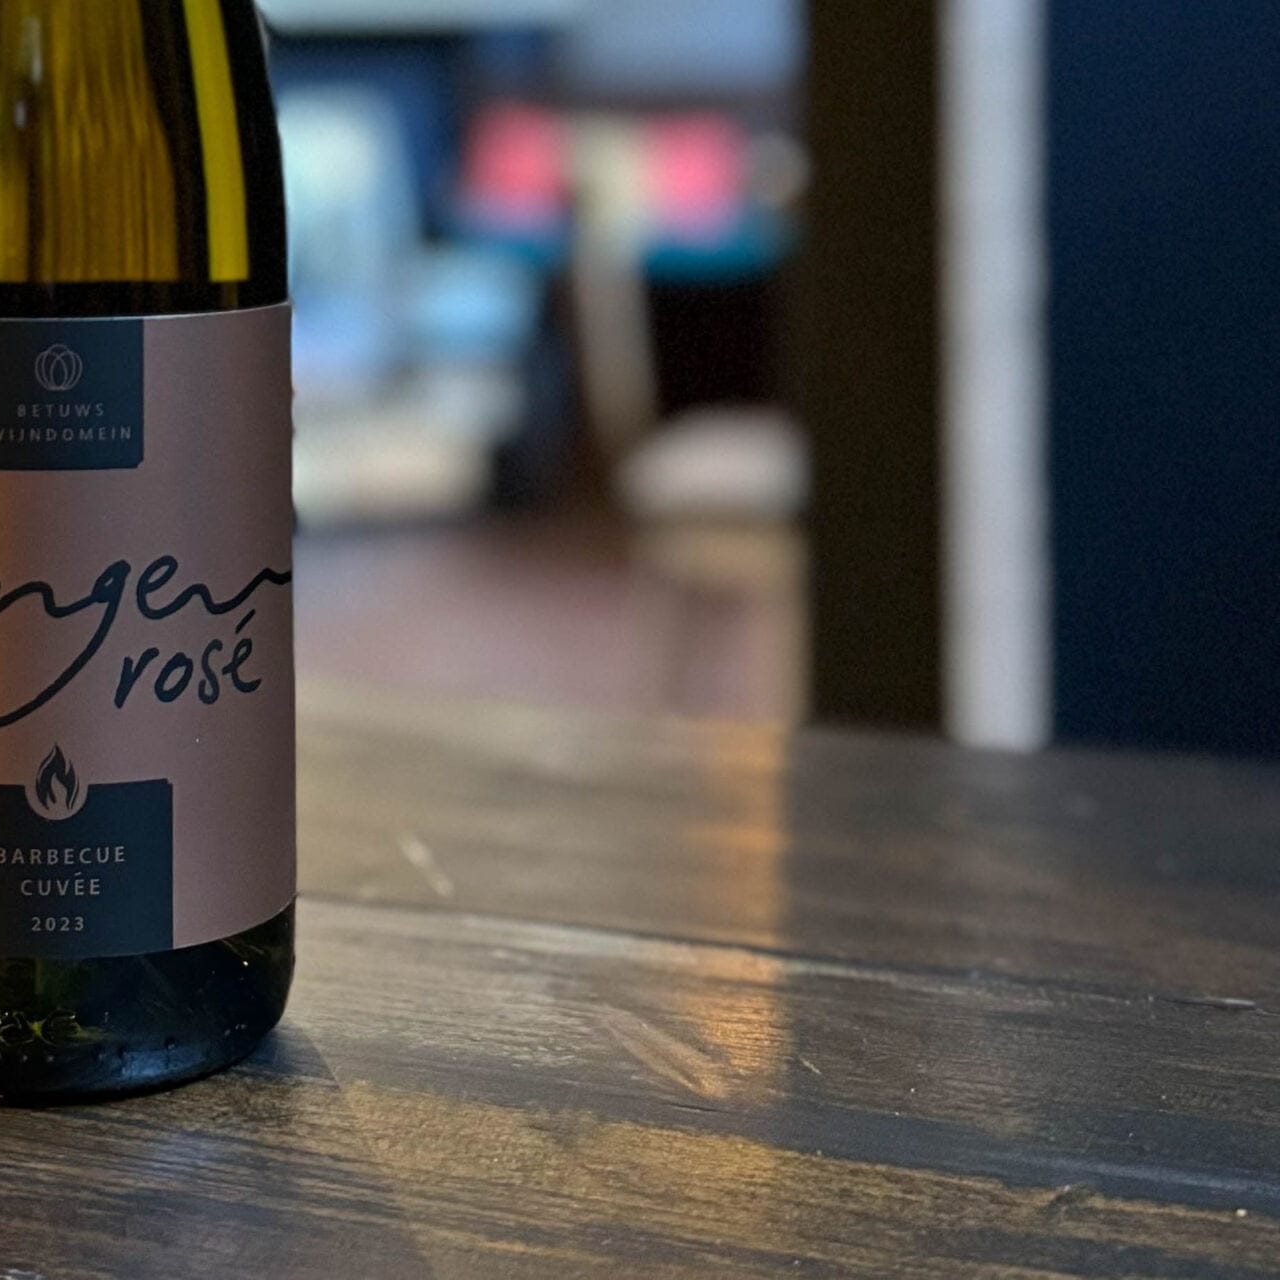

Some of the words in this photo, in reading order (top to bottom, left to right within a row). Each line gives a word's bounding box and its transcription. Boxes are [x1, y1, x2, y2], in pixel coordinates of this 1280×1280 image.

[17, 402, 106, 418] BETUWS
[114, 609, 262, 709] rosé
[20, 872, 102, 897] CUVÉE
[31, 917, 85, 932] 2023
